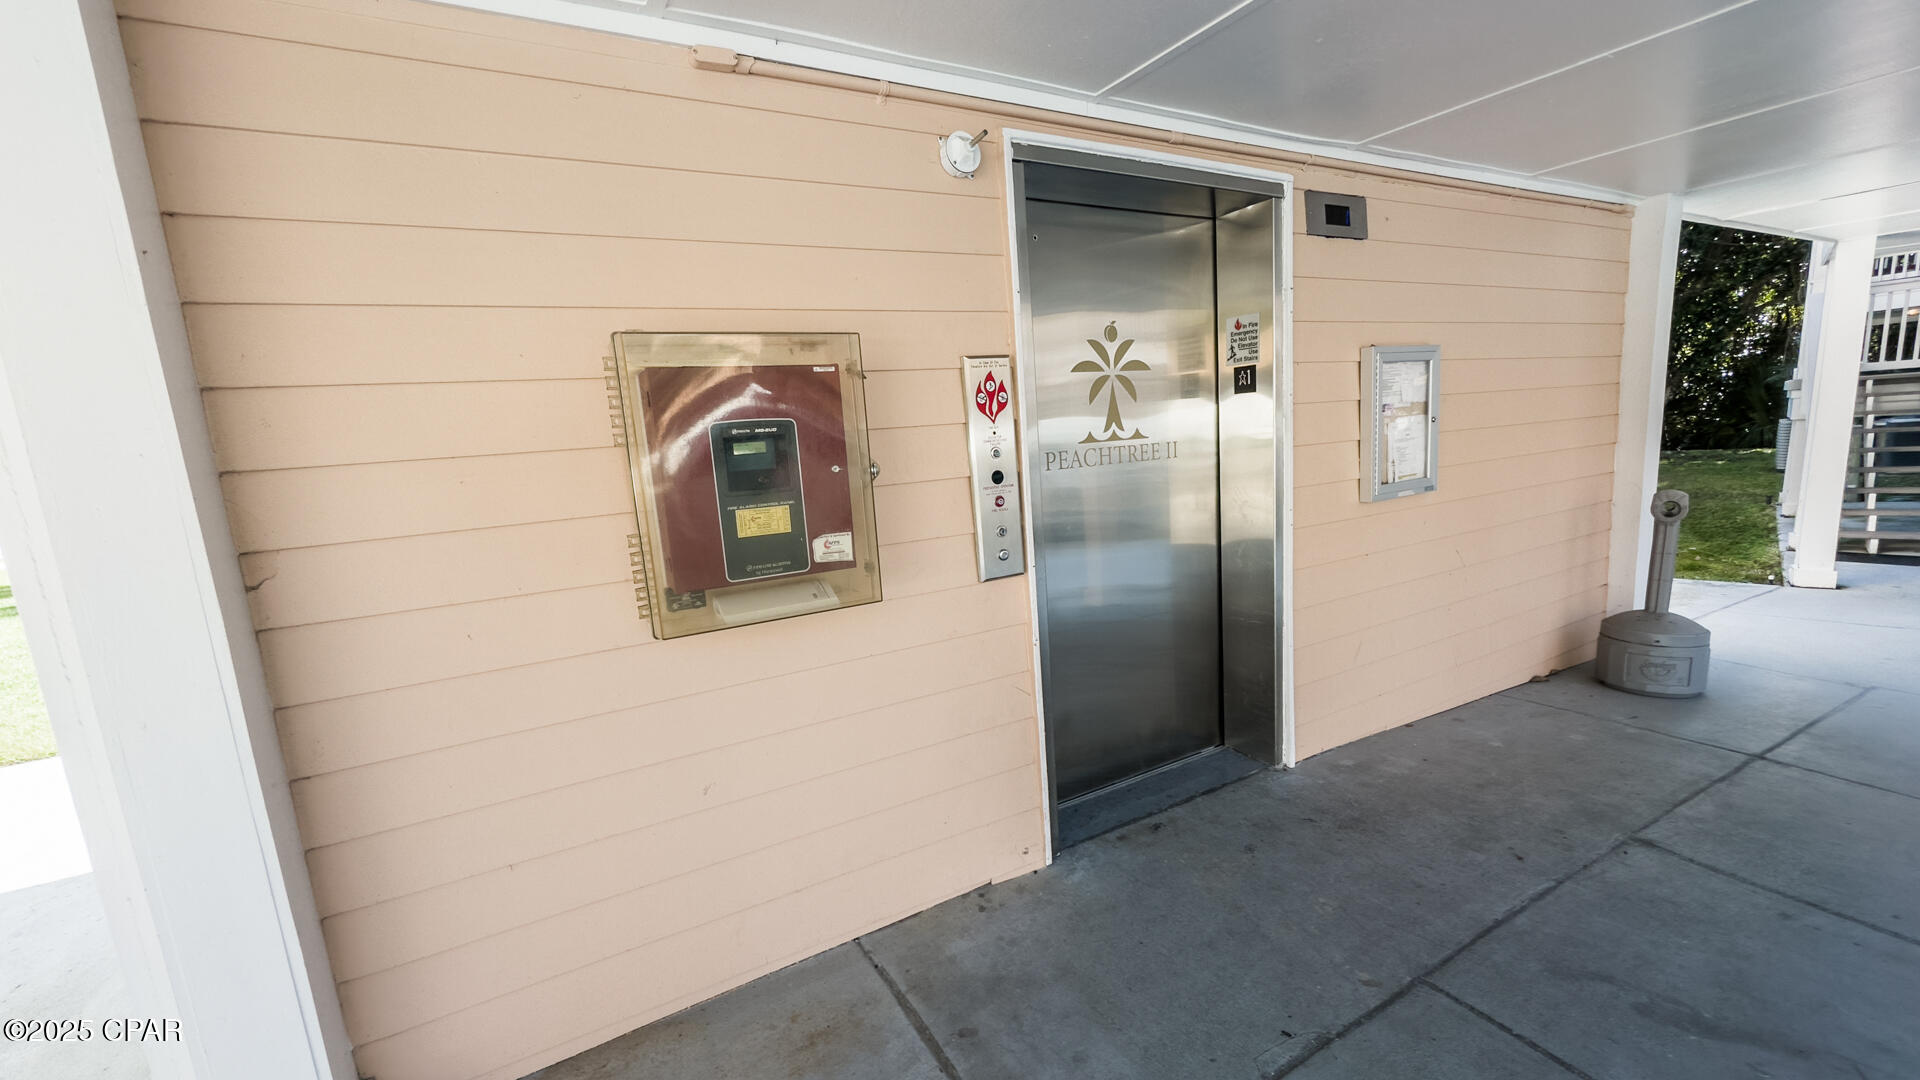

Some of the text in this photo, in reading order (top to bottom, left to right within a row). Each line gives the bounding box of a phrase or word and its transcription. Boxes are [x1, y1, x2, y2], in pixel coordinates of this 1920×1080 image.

[1230, 329, 1258, 338] Emergency
[1237, 341, 1258, 349] Elevator
[1044, 441, 1178, 472] PEACHTREE II
